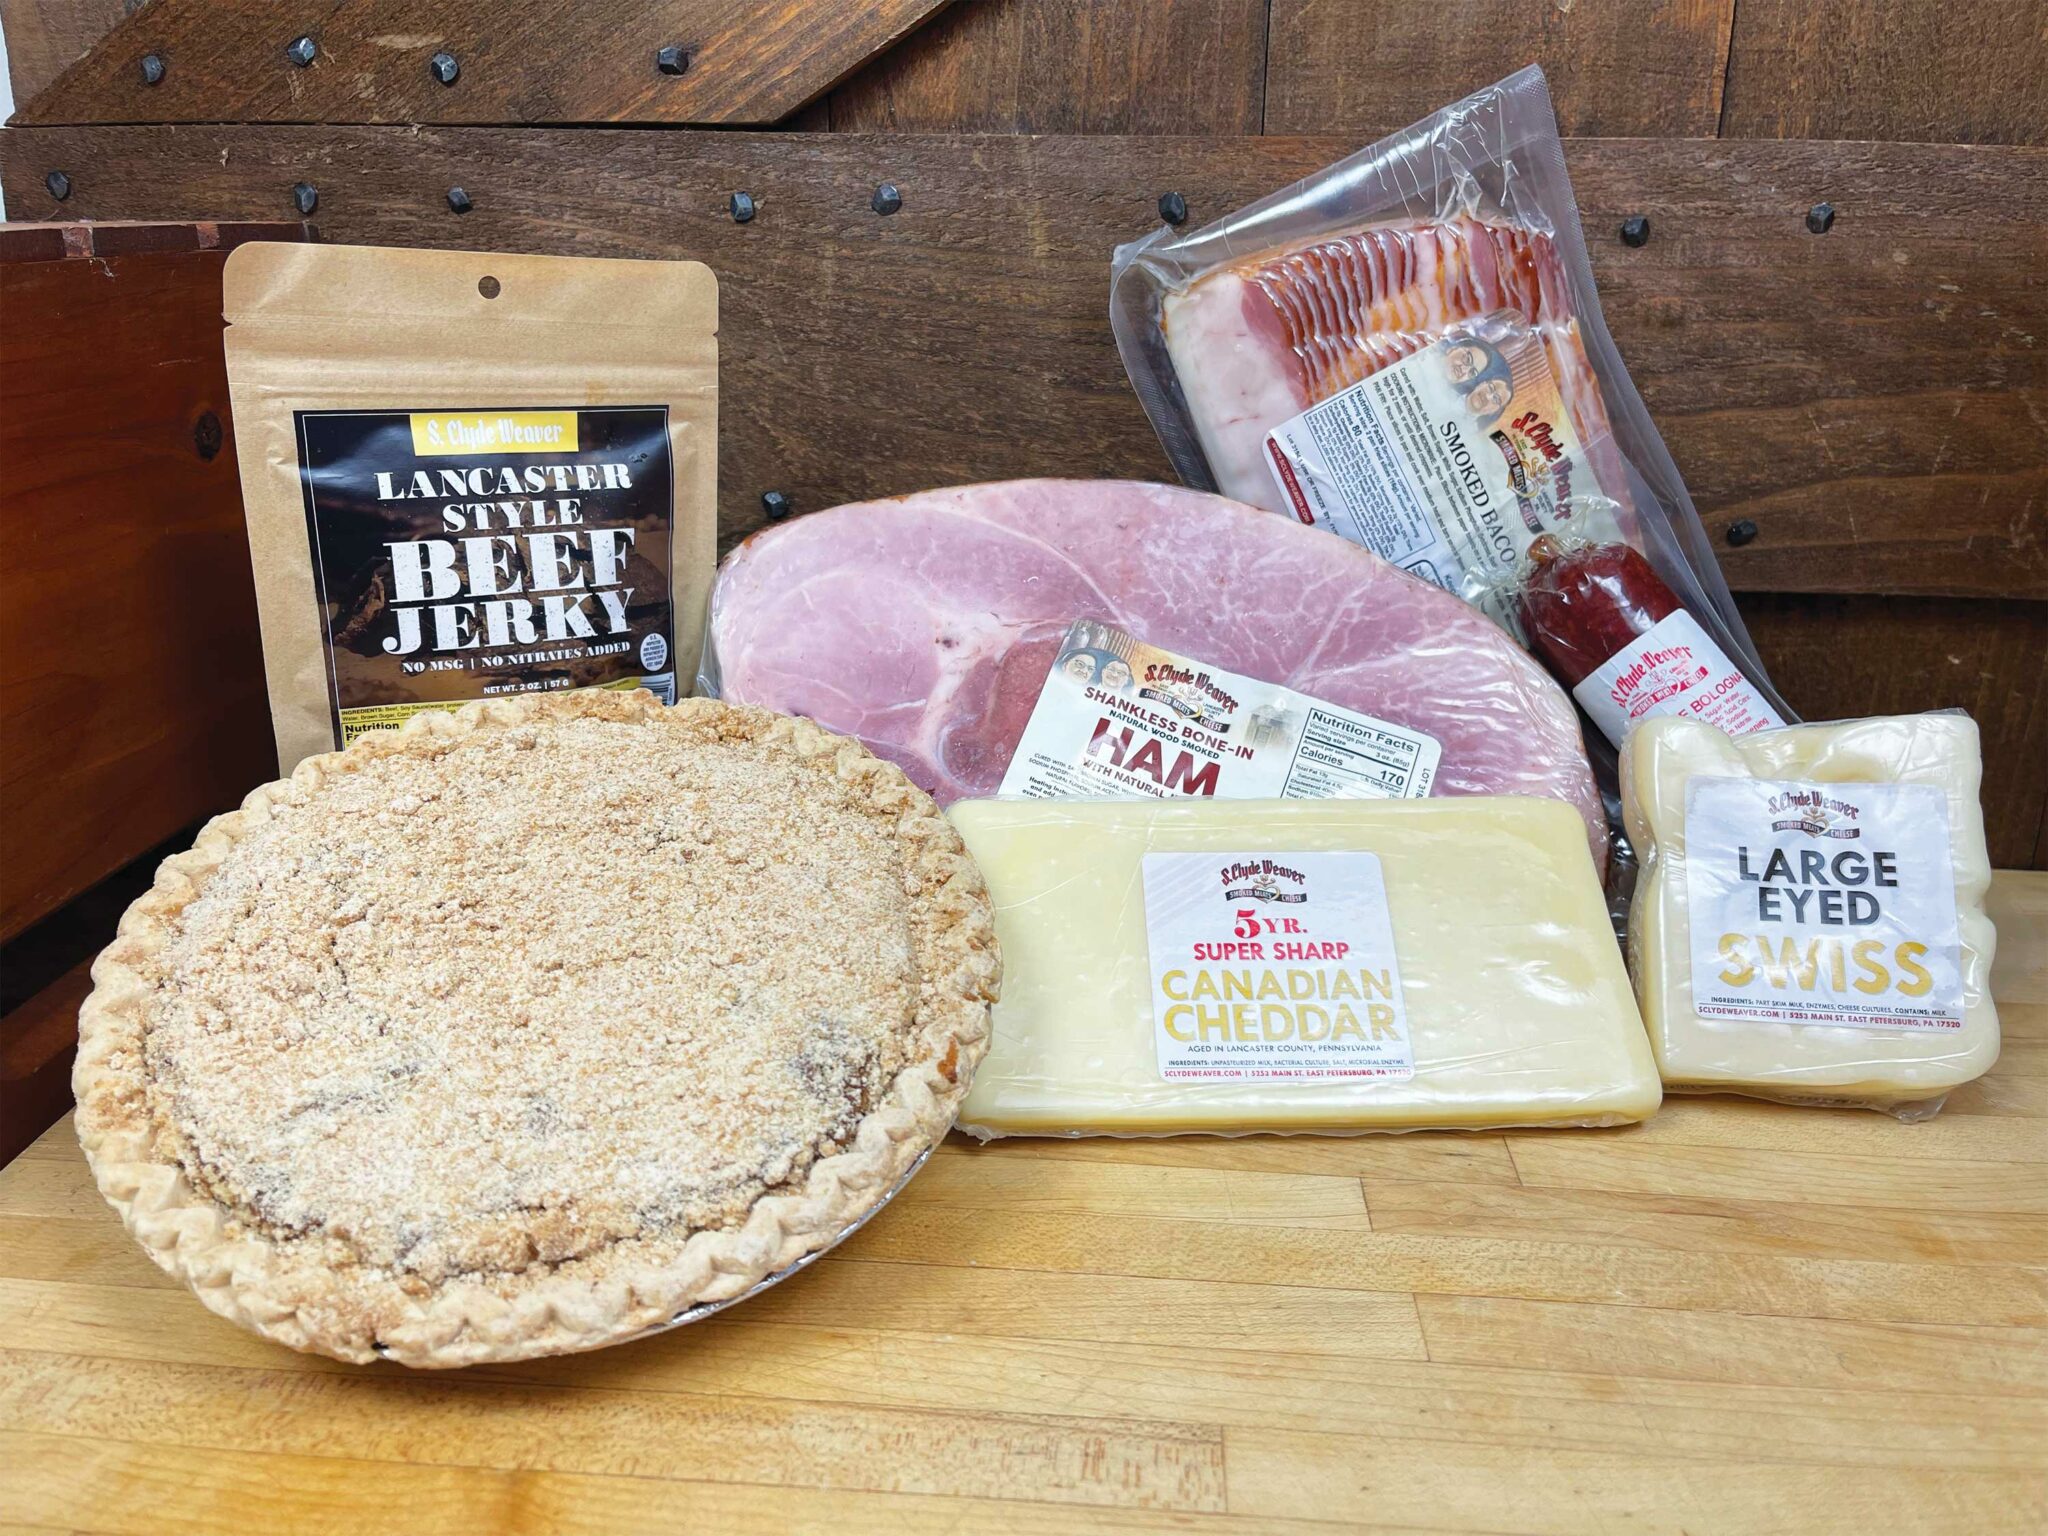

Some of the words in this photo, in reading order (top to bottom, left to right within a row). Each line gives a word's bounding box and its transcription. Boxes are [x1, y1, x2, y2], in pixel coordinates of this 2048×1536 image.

[1337, 398, 1354, 426] Calories
[1354, 389, 1375, 424] Nutrition
[1370, 422, 1386, 445] Facts
[1389, 371, 1405, 396] COOKING
[1400, 395, 1423, 433] INSTRUCTIONS
[427, 419, 444, 446] S.
[447, 419, 496, 448] Clyde
[497, 418, 563, 444] Weaver
[1346, 393, 1362, 417] Serving
[1366, 434, 1376, 447] pan
[1373, 446, 1384, 461] fried
[1379, 460, 1392, 477] slices
[1524, 422, 1564, 462] Clyde
[1499, 436, 1518, 465] SMOKED
[374, 463, 633, 500] LANCASTER
[1310, 485, 1326, 510] FREEZE
[1440, 421, 1489, 508] SMOKED
[1481, 509, 1516, 563] BACO
[443, 498, 583, 533] STYLE
[382, 528, 635, 603] BEEF
[382, 588, 635, 655] JERKY
[402, 661, 425, 673] NO
[430, 659, 464, 671] MSG
[481, 656, 503, 668] NO
[508, 647, 582, 665] NITRATES
[585, 641, 630, 658] ADDED
[1616, 664, 1646, 697] Clyde
[1640, 647, 1693, 670] Weaver
[484, 686, 501, 695] NET
[502, 684, 518, 693] WT.
[519, 683, 526, 691] 2
[527, 682, 542, 690] OZ.
[550, 680, 561, 688] 57
[562, 678, 569, 687] G
[1157, 664, 1194, 685] Clyde
[1195, 672, 1239, 715] Weaver
[1690, 672, 1743, 713] BOLOGNA
[341, 707, 382, 715] INGREDIENTS:
[1084, 686, 1178, 733] SHANKLESS
[1181, 726, 1255, 760] BONE-IN
[1144, 689, 1172, 705] SMOKED
[1173, 699, 1191, 716] MEATS
[1199, 717, 1224, 732] CHEESE
[1726, 708, 1748, 724] Sodium
[345, 722, 399, 733] Nutrition
[1109, 709, 1148, 732] NATURAL
[1151, 727, 1179, 744] WOOD
[1181, 740, 1220, 760] SMOKED
[1307, 728, 1332, 743] Serving
[1332, 737, 1347, 746] size
[1309, 721, 1329, 733] Varied
[1330, 729, 1355, 743] servings
[1355, 738, 1366, 747] per
[1367, 741, 1396, 755] container
[1312, 711, 1372, 739] Nutrition
[1376, 733, 1414, 752] Facts
[1086, 717, 1221, 799] HAM
[1301, 746, 1344, 766] Calories
[1303, 739, 1324, 750] Amount
[1324, 745, 1334, 753] per
[1335, 748, 1354, 760] serving
[1029, 776, 1052, 790] Heating
[1083, 758, 1112, 776] WITH
[1114, 771, 1165, 798] NATURAL
[1380, 770, 1404, 786] 170
[1420, 768, 1431, 784] LOT
[1768, 796, 1780, 816] S.
[1780, 791, 1812, 811] Clyde
[1811, 791, 1859, 820] Weaver
[1803, 823, 1820, 833] MEATS
[1831, 830, 1854, 838] CHEESE
[1221, 867, 1233, 886] S.
[1231, 860, 1261, 880] Clyde
[1262, 859, 1306, 885] Weaver
[1738, 846, 1898, 888] LARGE
[1229, 889, 1253, 899] SMOKED
[1254, 890, 1272, 899] MEATS
[1759, 886, 1881, 926] EYED
[1234, 909, 1261, 939] 5
[1263, 918, 1308, 934] YR.
[1193, 942, 1265, 961] SUPER
[1273, 942, 1349, 960] SHARP
[1717, 932, 1934, 997] SWISS
[1161, 969, 1392, 1001] CANADIAN
[1698, 1006, 1779, 1018] SCLYDEWEAVER.COM
[1870, 1017, 1921, 1027] PETERSBURG,
[1711, 997, 1754, 1005] INGREDIENTS:
[1806, 1002, 1836, 1010] ENZYMES,
[1164, 1003, 1401, 1042] CHEDDAR
[1187, 1045, 1211, 1053] AGED
[1214, 1045, 1224, 1053] IN
[1227, 1045, 1274, 1053] LANCASTER
[1277, 1045, 1316, 1053] COUNTY,
[1318, 1044, 1382, 1052] PENNSYLVANIA
[1326, 1069, 1375, 1077] PETERSBURG,
